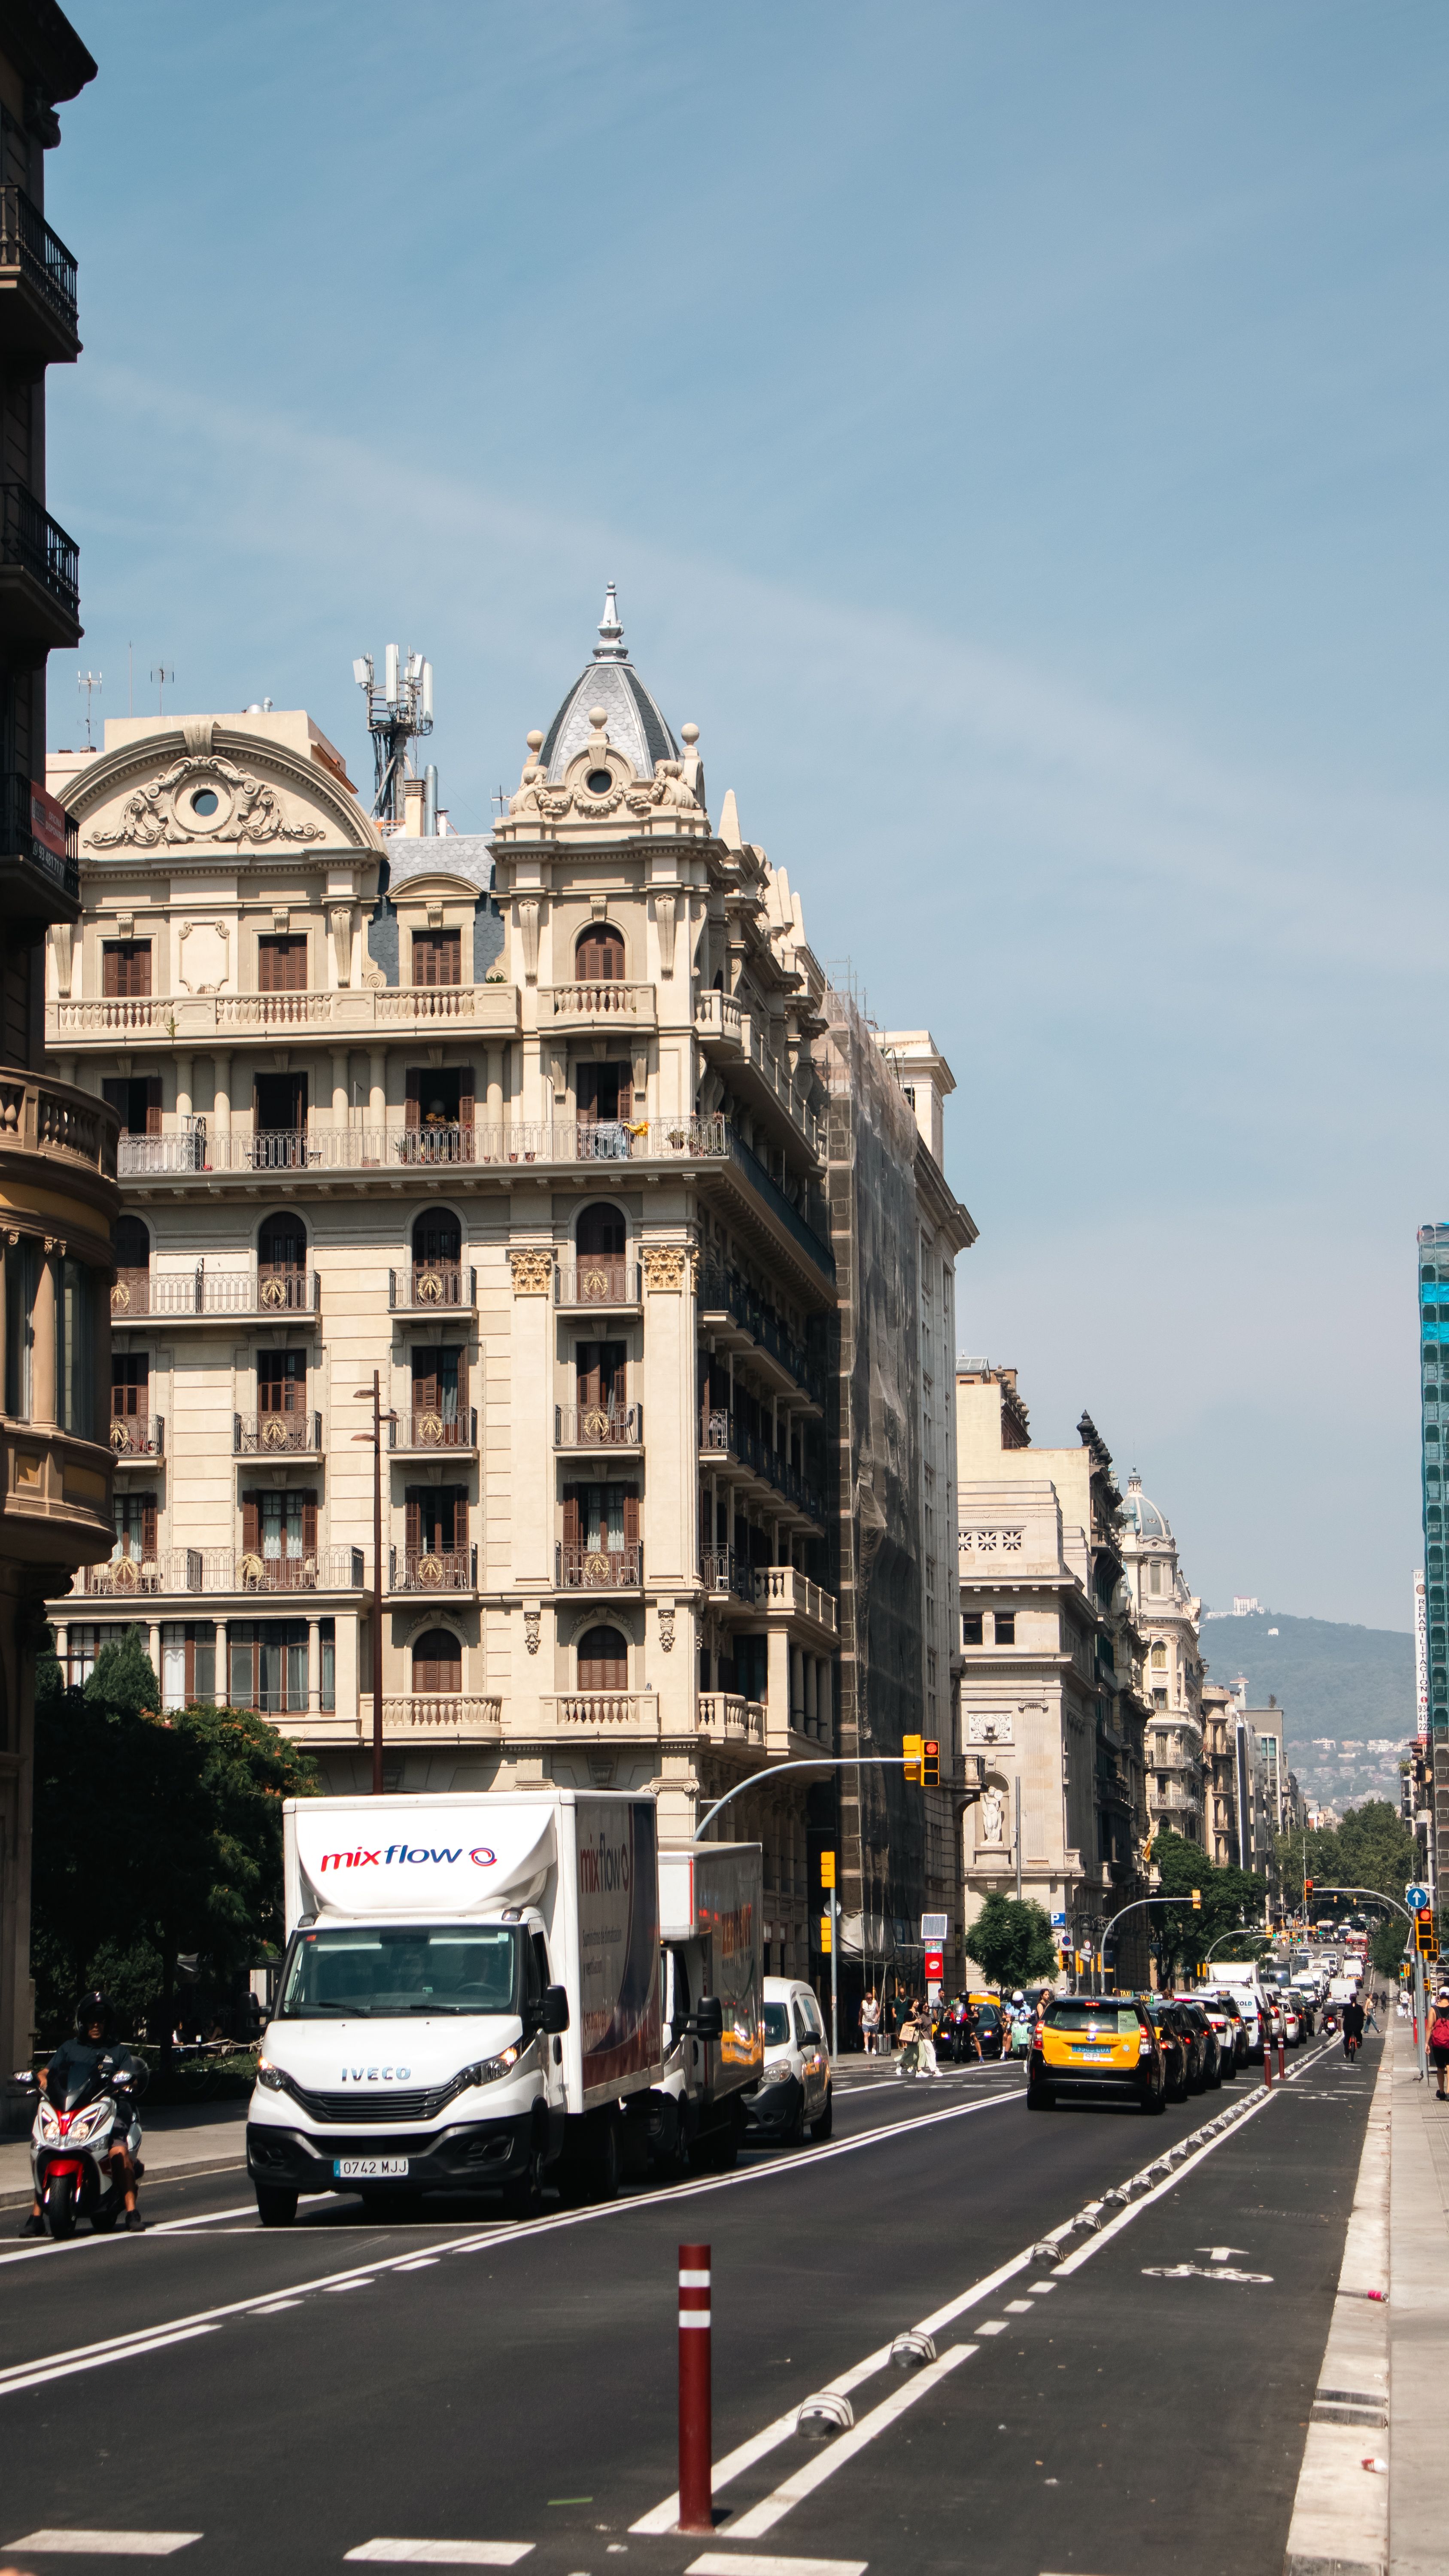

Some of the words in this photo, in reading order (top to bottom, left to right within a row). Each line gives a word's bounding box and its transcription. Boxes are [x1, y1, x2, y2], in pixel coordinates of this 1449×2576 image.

[49, 811, 61, 828] OFICINA
[46, 821, 64, 842] DISPONIBLE
[39, 845, 44, 861] 93
[54, 857, 59, 873] 71
[59, 862, 64, 878] 71
[1418, 1599, 1428, 1692] REHABILITACION
[321, 1845, 463, 1872] mixflow
[580, 1832, 620, 1894] mixflow
[1051, 1913, 1060, 1924] P
[342, 2066, 411, 2082] IVECO
[344, 2161, 377, 2174] 0742
[382, 2160, 406, 2173] MJJ
